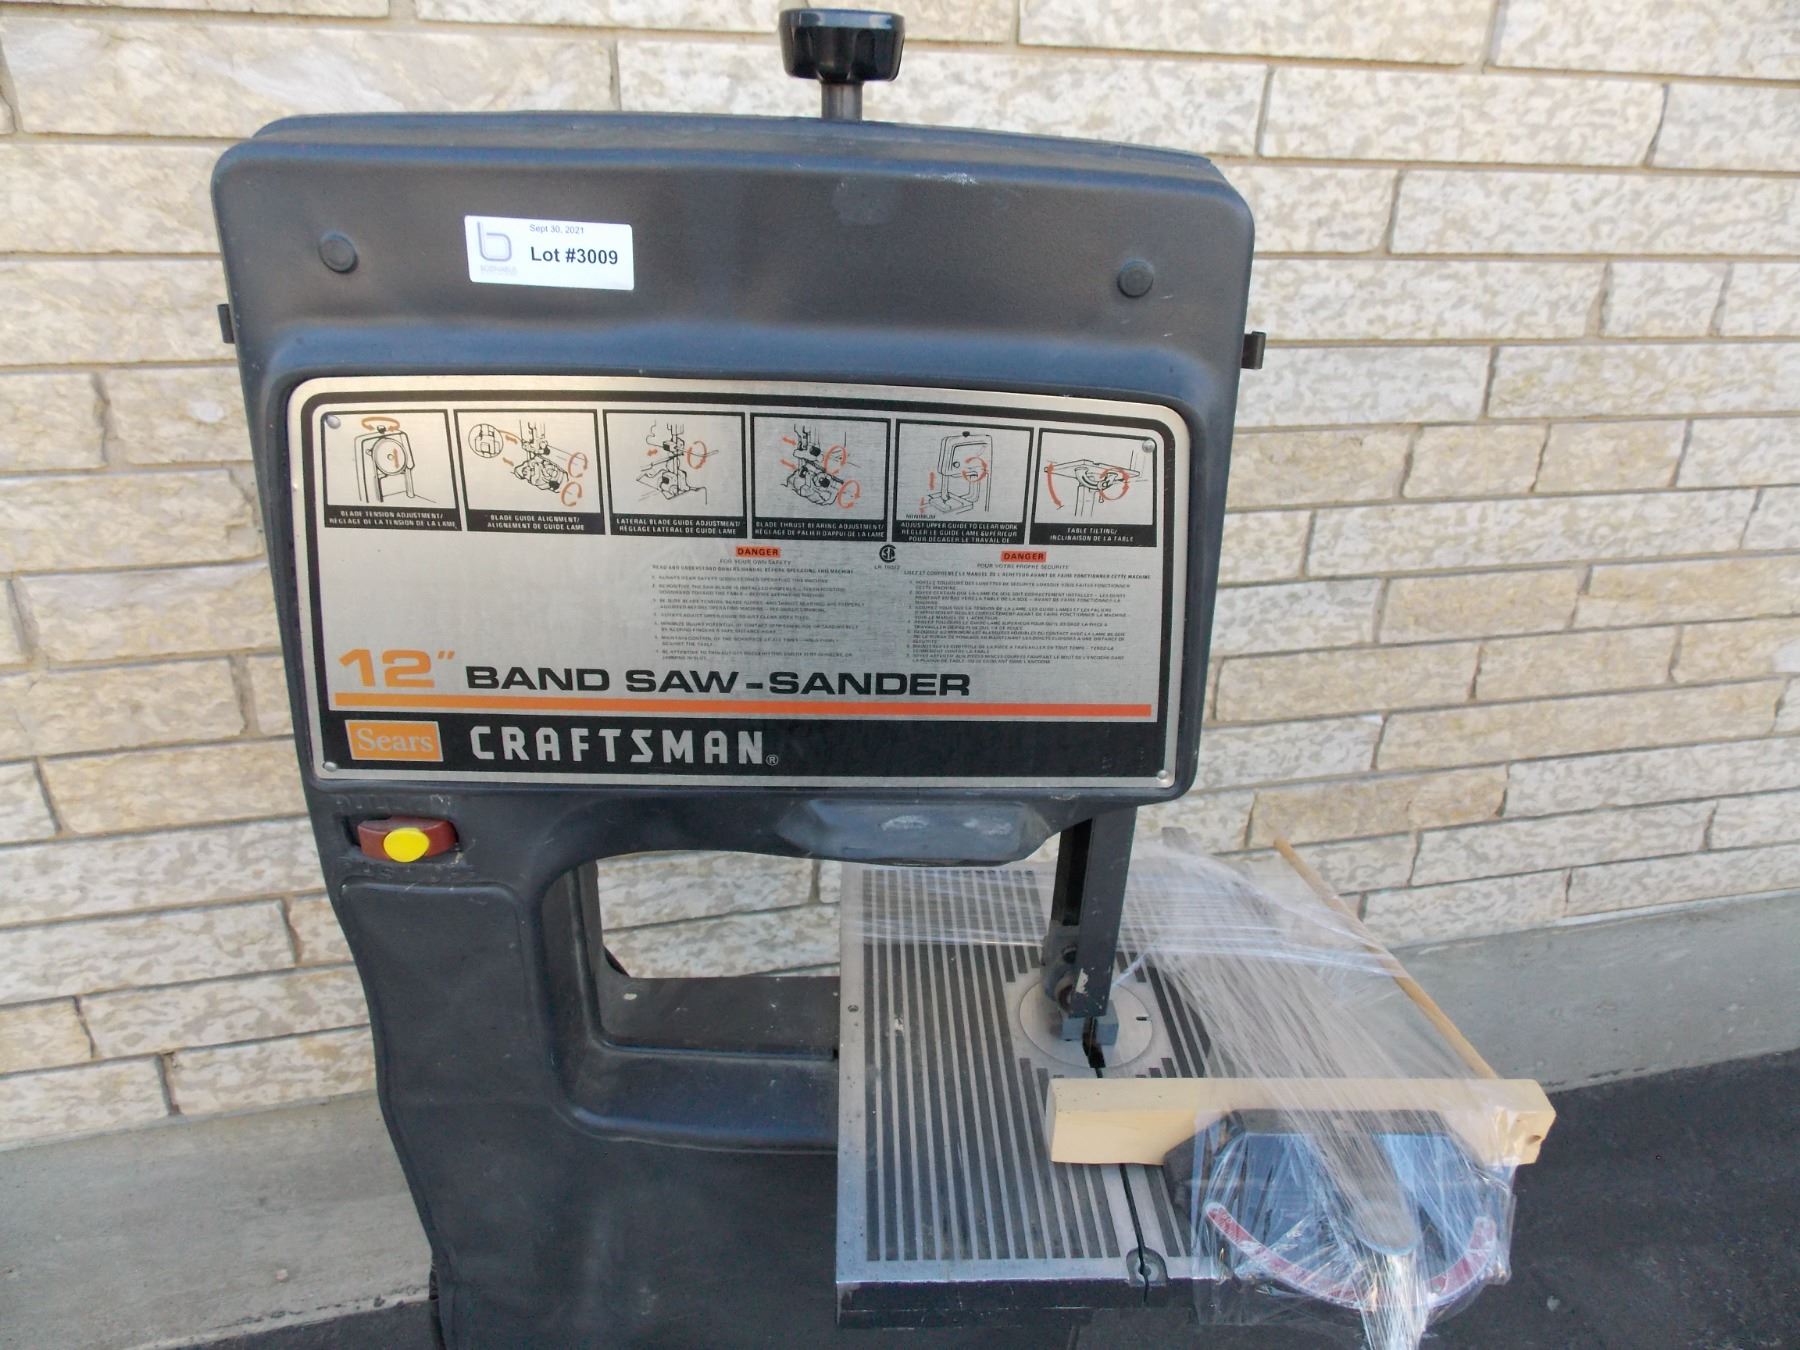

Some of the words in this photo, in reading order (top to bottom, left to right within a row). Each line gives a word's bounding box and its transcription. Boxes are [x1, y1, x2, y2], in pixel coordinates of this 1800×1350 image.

[529, 224, 548, 236] Sept
[564, 226, 585, 236] 2021
[530, 246, 560, 262] Lot
[566, 248, 618, 265] #3009
[737, 548, 779, 556] DANGER
[1003, 552, 1044, 561] DANGER
[339, 648, 455, 688] 12"
[465, 665, 610, 692] BAND
[355, 727, 434, 753] Sears
[469, 725, 763, 764] CRAFTSMAN
